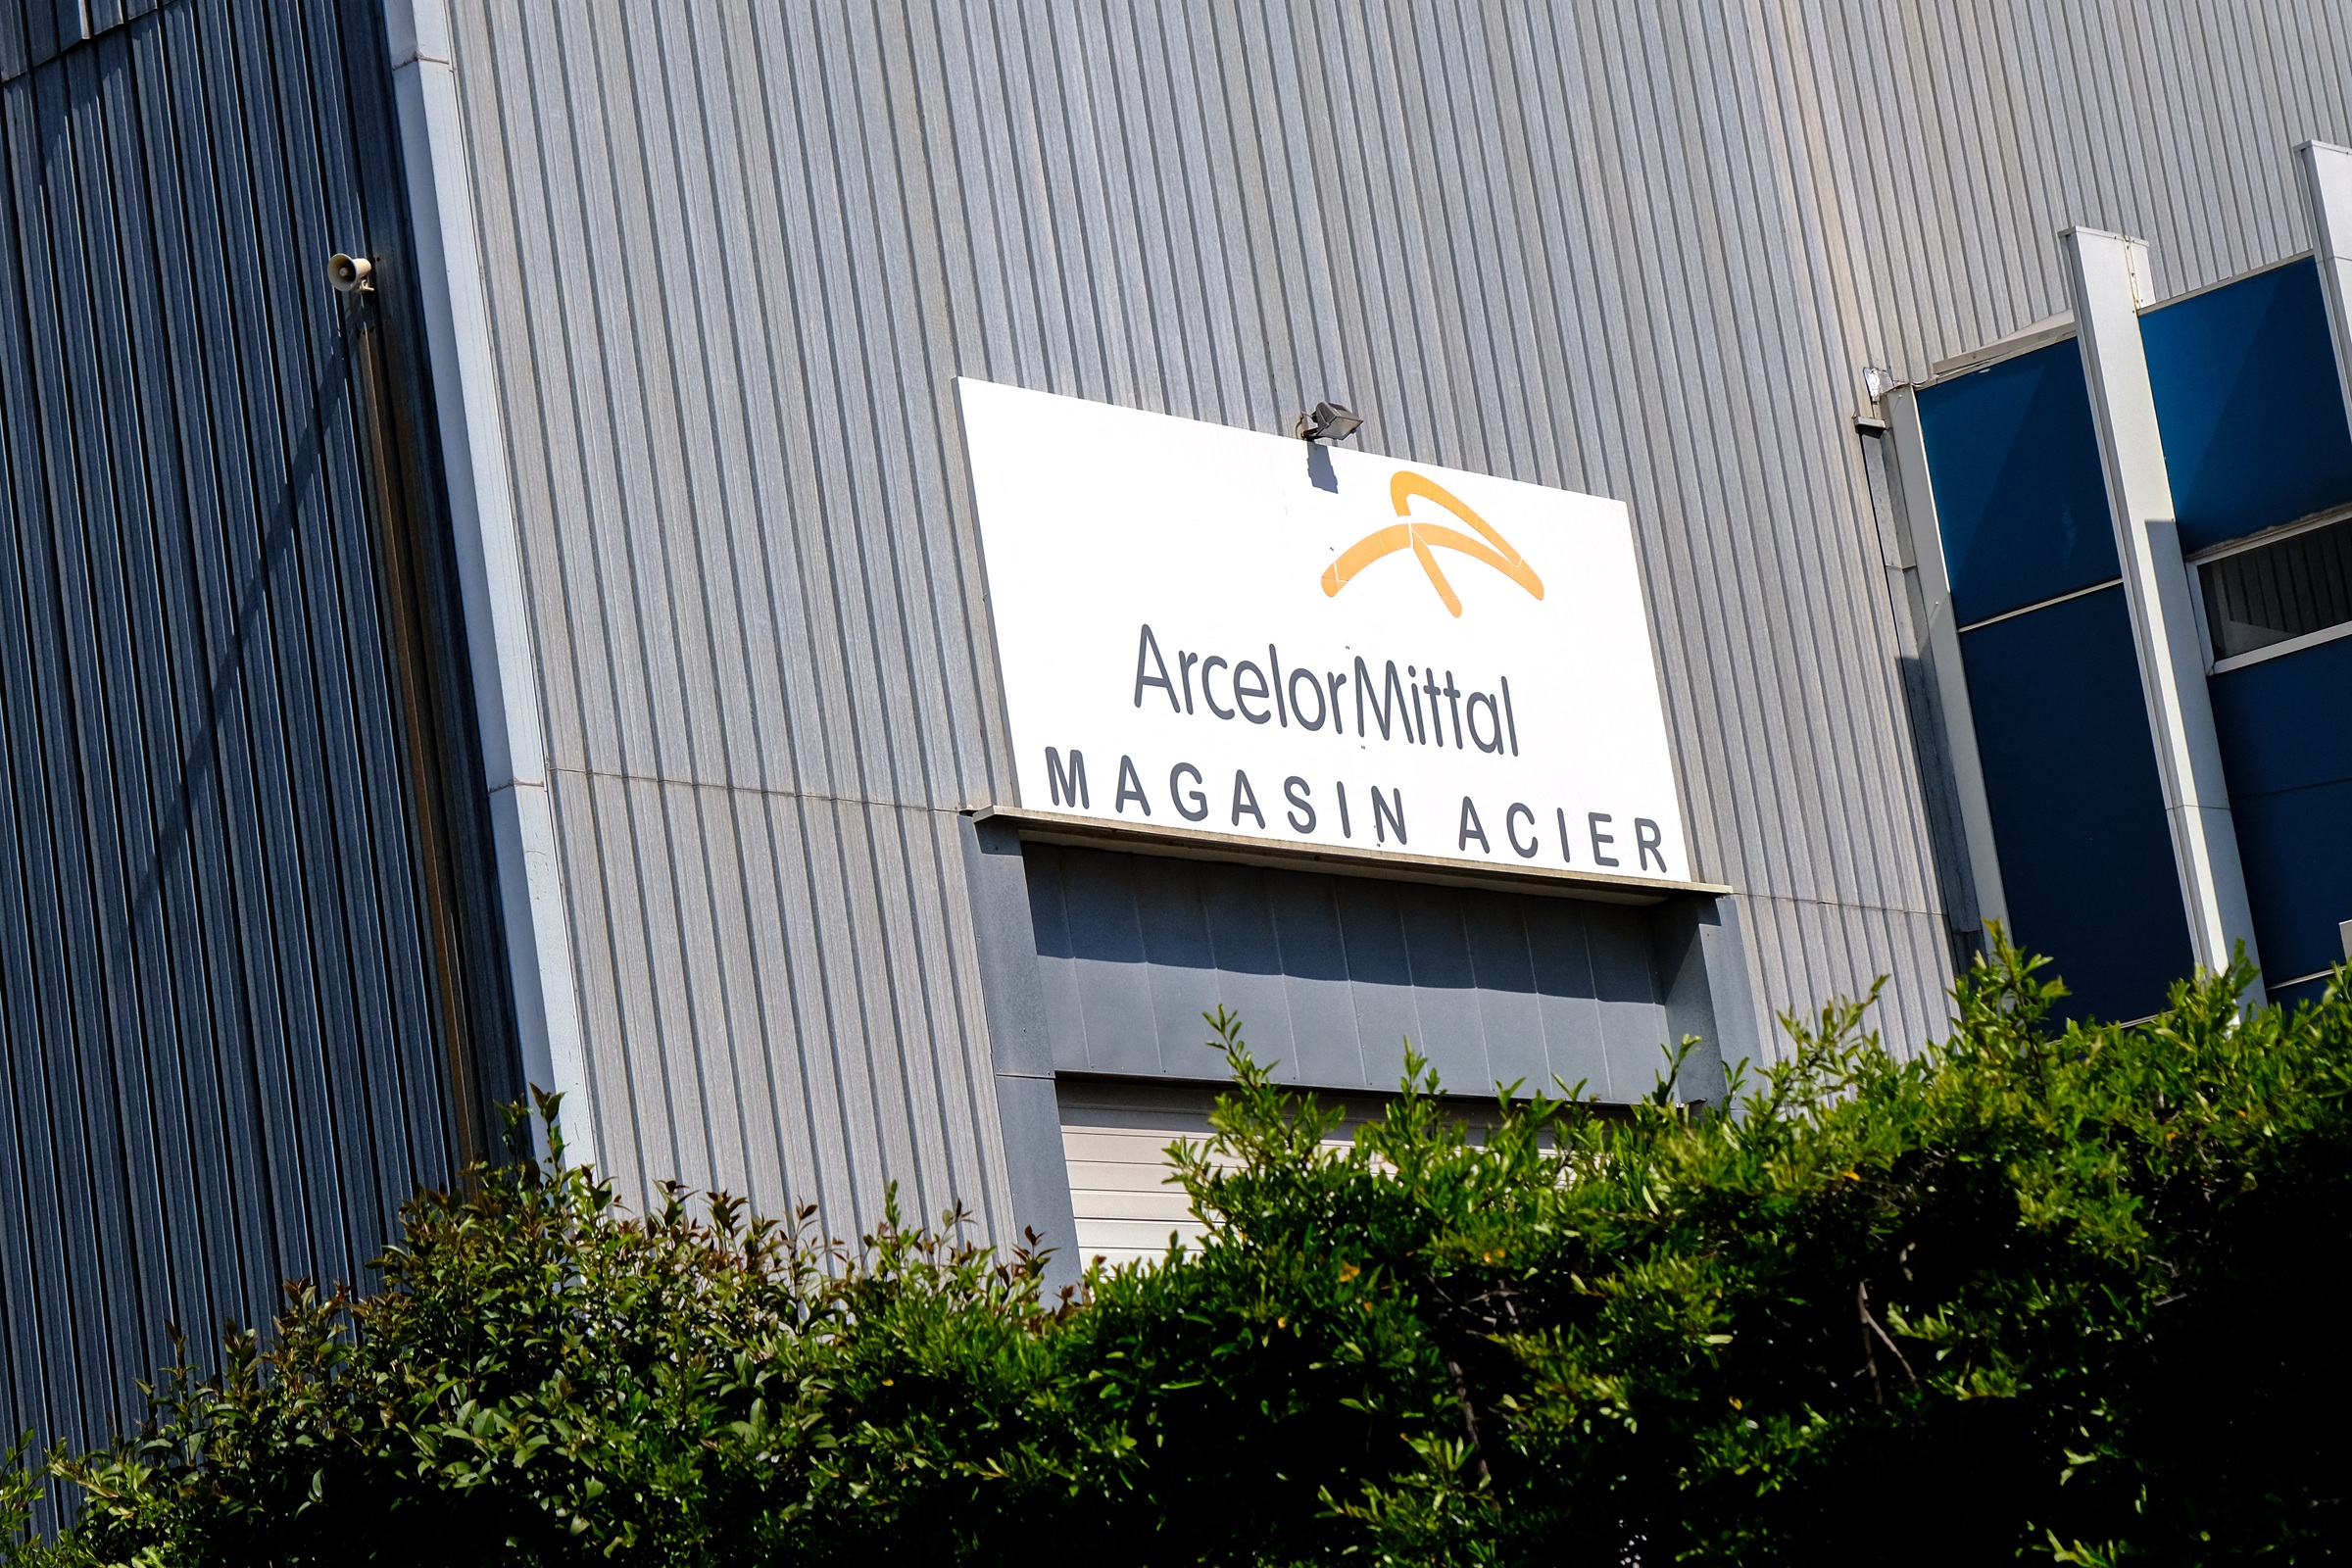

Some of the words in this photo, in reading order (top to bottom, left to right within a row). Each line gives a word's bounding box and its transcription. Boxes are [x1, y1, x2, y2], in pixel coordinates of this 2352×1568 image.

[1134, 623, 1519, 758] ArcelorMittal
[1045, 746, 1408, 846] MAGASIN
[1458, 796, 1667, 873] ACIER
